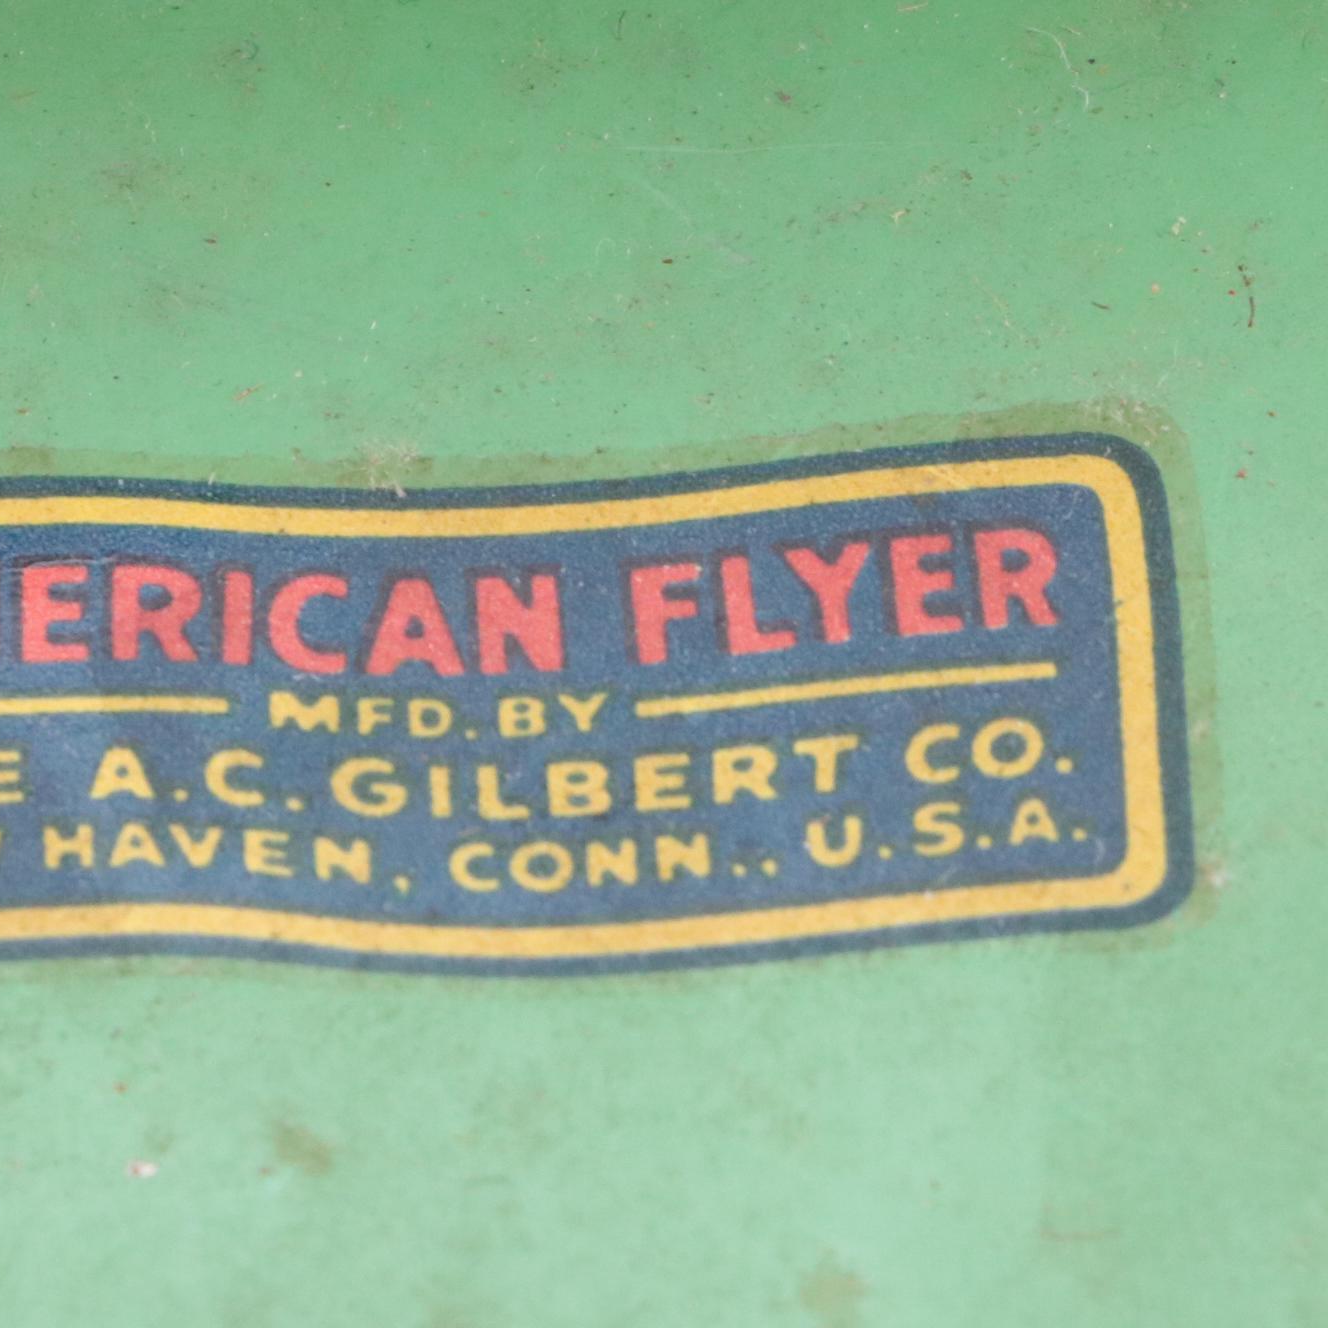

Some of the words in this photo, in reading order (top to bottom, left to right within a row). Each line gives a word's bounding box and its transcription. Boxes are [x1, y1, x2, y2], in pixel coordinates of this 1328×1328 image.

[628, 526, 1060, 666] FLYER
[267, 690, 478, 740] MFD.
[497, 691, 608, 739] BY
[329, 732, 861, 821] GILBERT
[904, 715, 1074, 785] CO.
[805, 797, 1088, 869] U.S.A.
